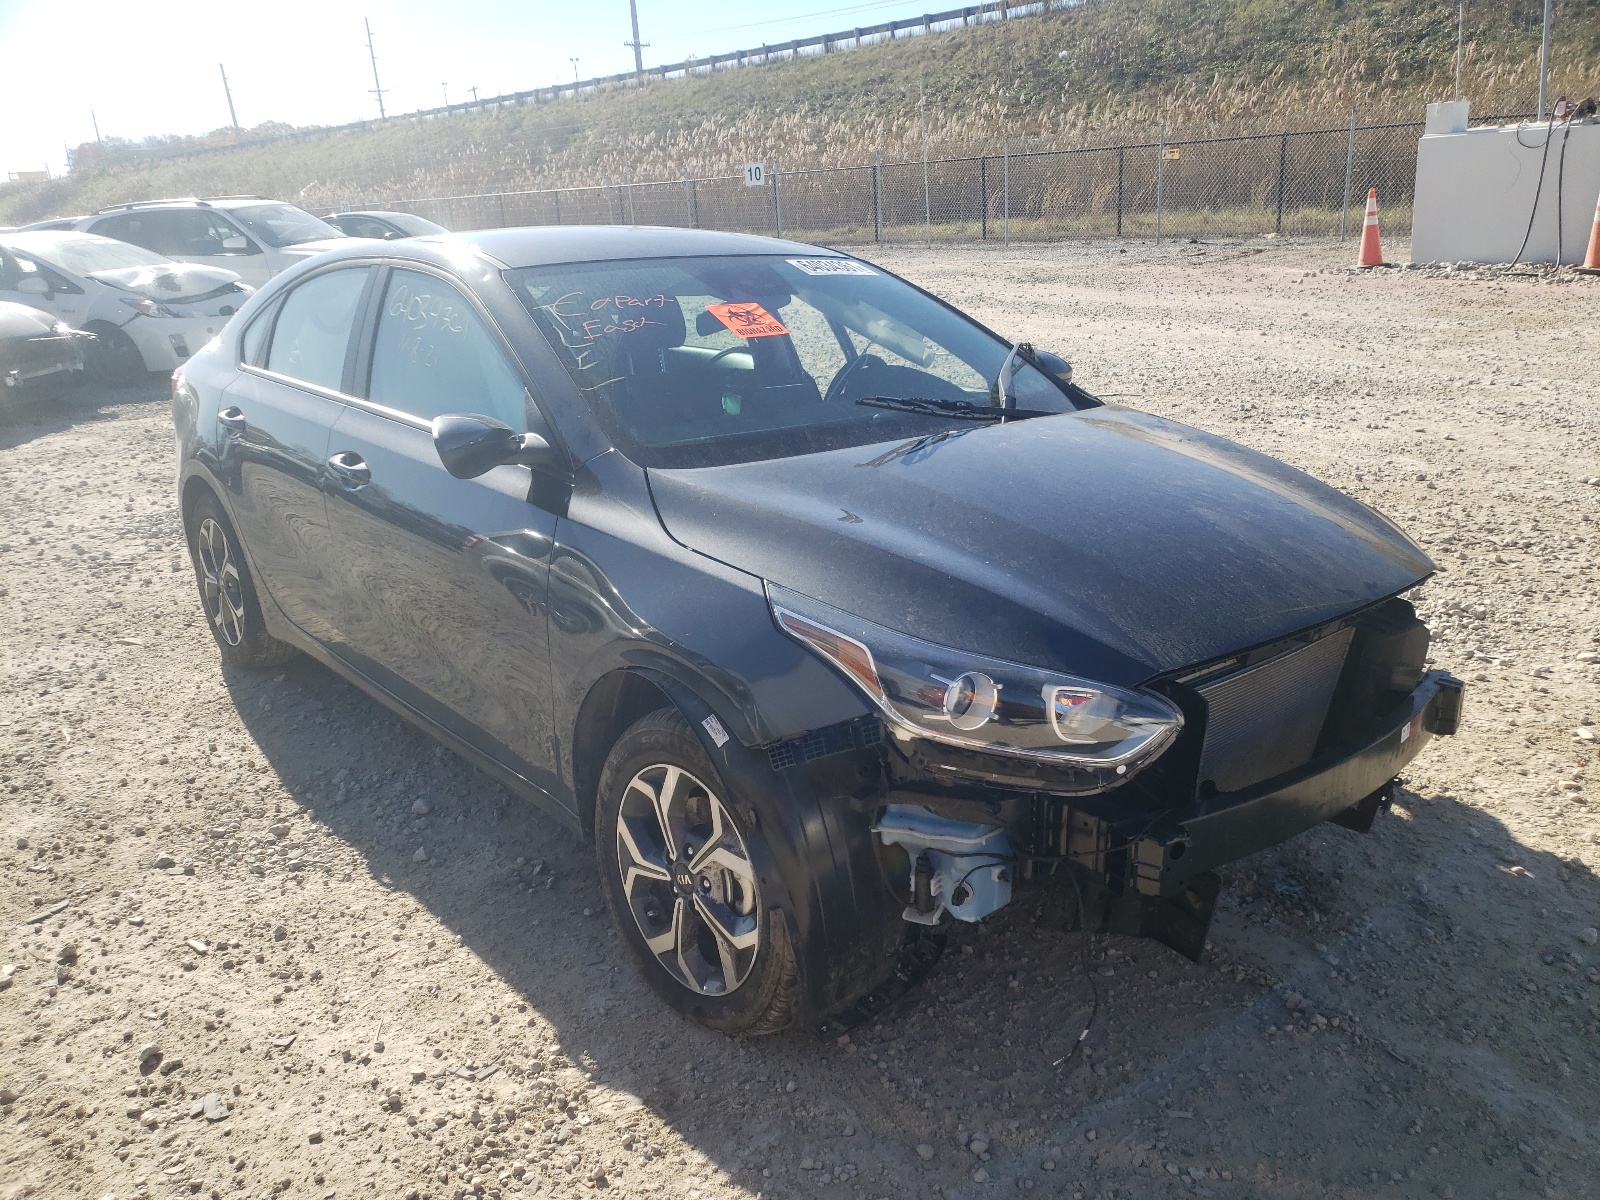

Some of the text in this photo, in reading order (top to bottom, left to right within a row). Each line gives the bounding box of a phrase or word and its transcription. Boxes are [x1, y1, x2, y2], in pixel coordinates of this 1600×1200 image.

[747, 166, 762, 181] 10
[736, 325, 784, 336] BIOHAZARD
[676, 874, 692, 885] KIA
